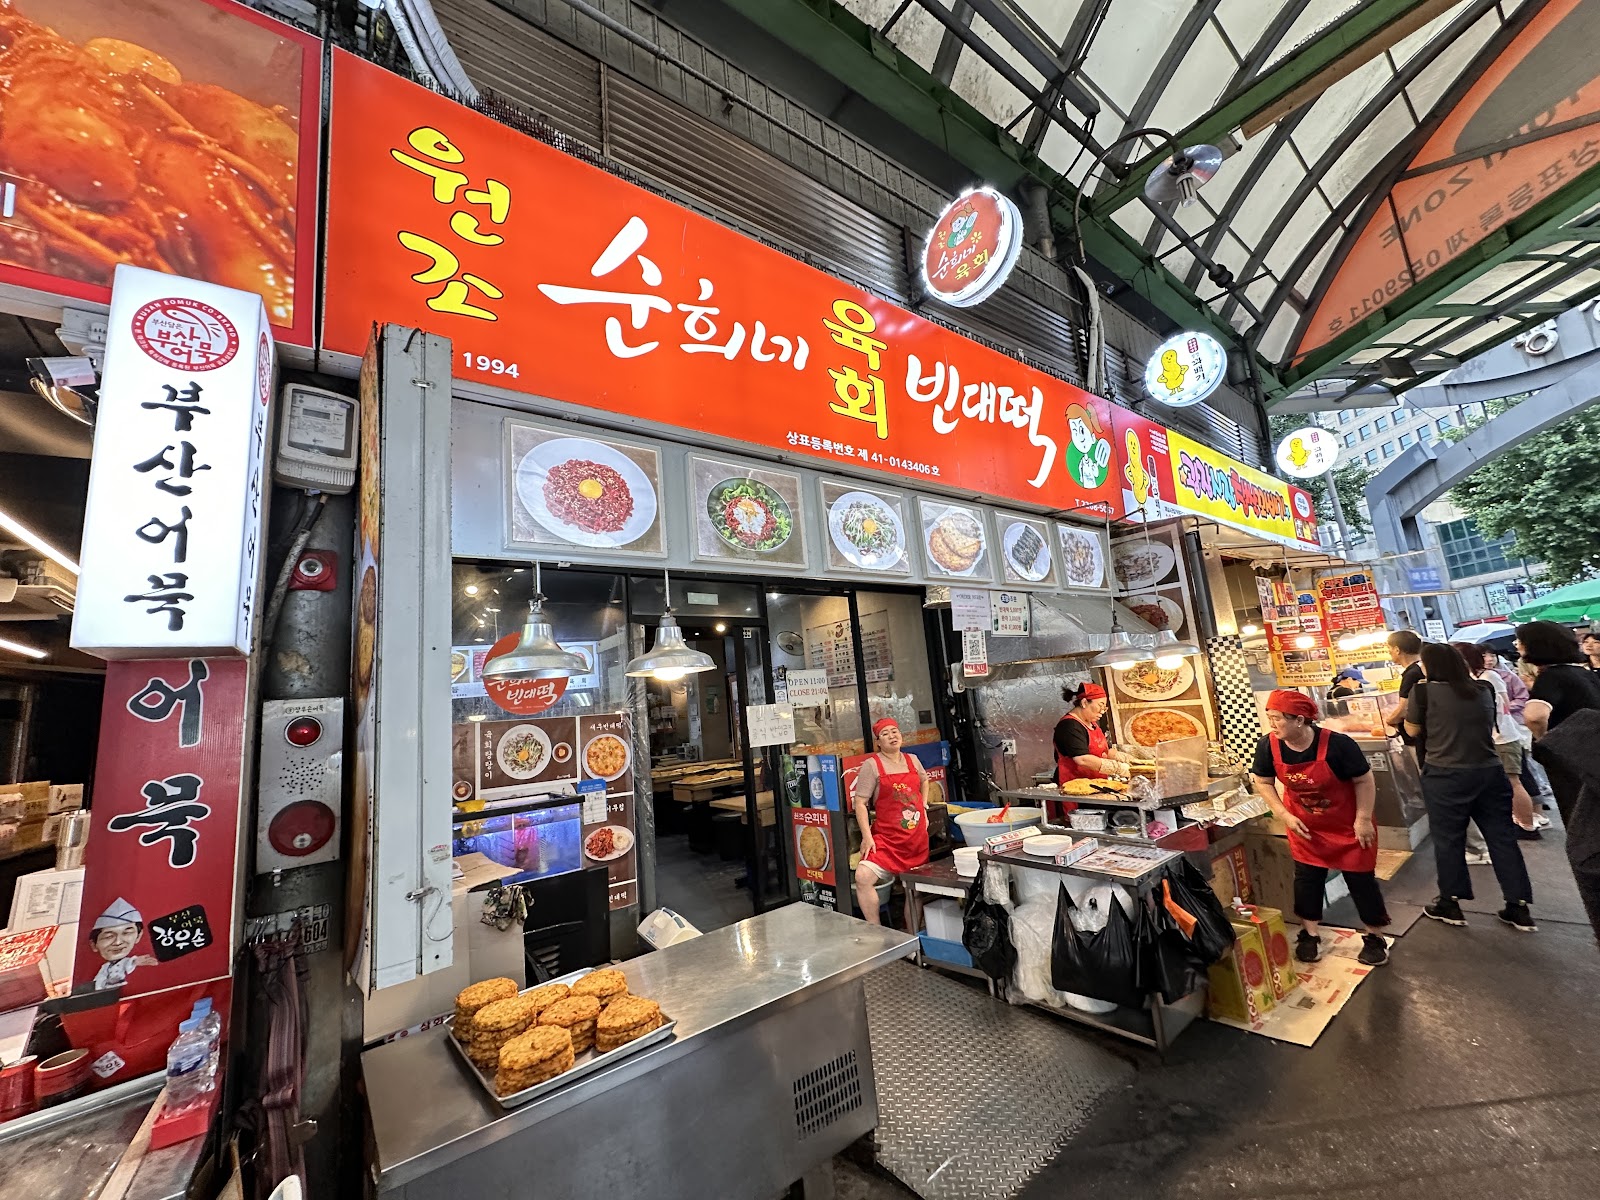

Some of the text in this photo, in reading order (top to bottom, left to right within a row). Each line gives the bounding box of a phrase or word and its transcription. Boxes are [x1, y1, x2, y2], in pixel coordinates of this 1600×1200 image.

[932, 243, 977, 280] 순희네
[954, 248, 989, 280] 육회
[537, 216, 809, 371] 순희네
[137, 302, 162, 321] BUSAN
[162, 299, 199, 308] EOMUK
[462, 352, 520, 379] 1994
[821, 297, 890, 441] 육회
[905, 354, 1057, 489] 빈대떡
[786, 431, 856, 457] 상표등록번호
[857, 449, 869, 462] 제
[124, 380, 212, 632] 부산어묵
[967, 664, 985, 672] MENU
[506, 682, 558, 706] 빈대떡
[789, 688, 810, 697] CLOSE
[107, 658, 212, 869] 어묵
[152, 925, 206, 950] 장우손
[304, 917, 327, 943] 604
